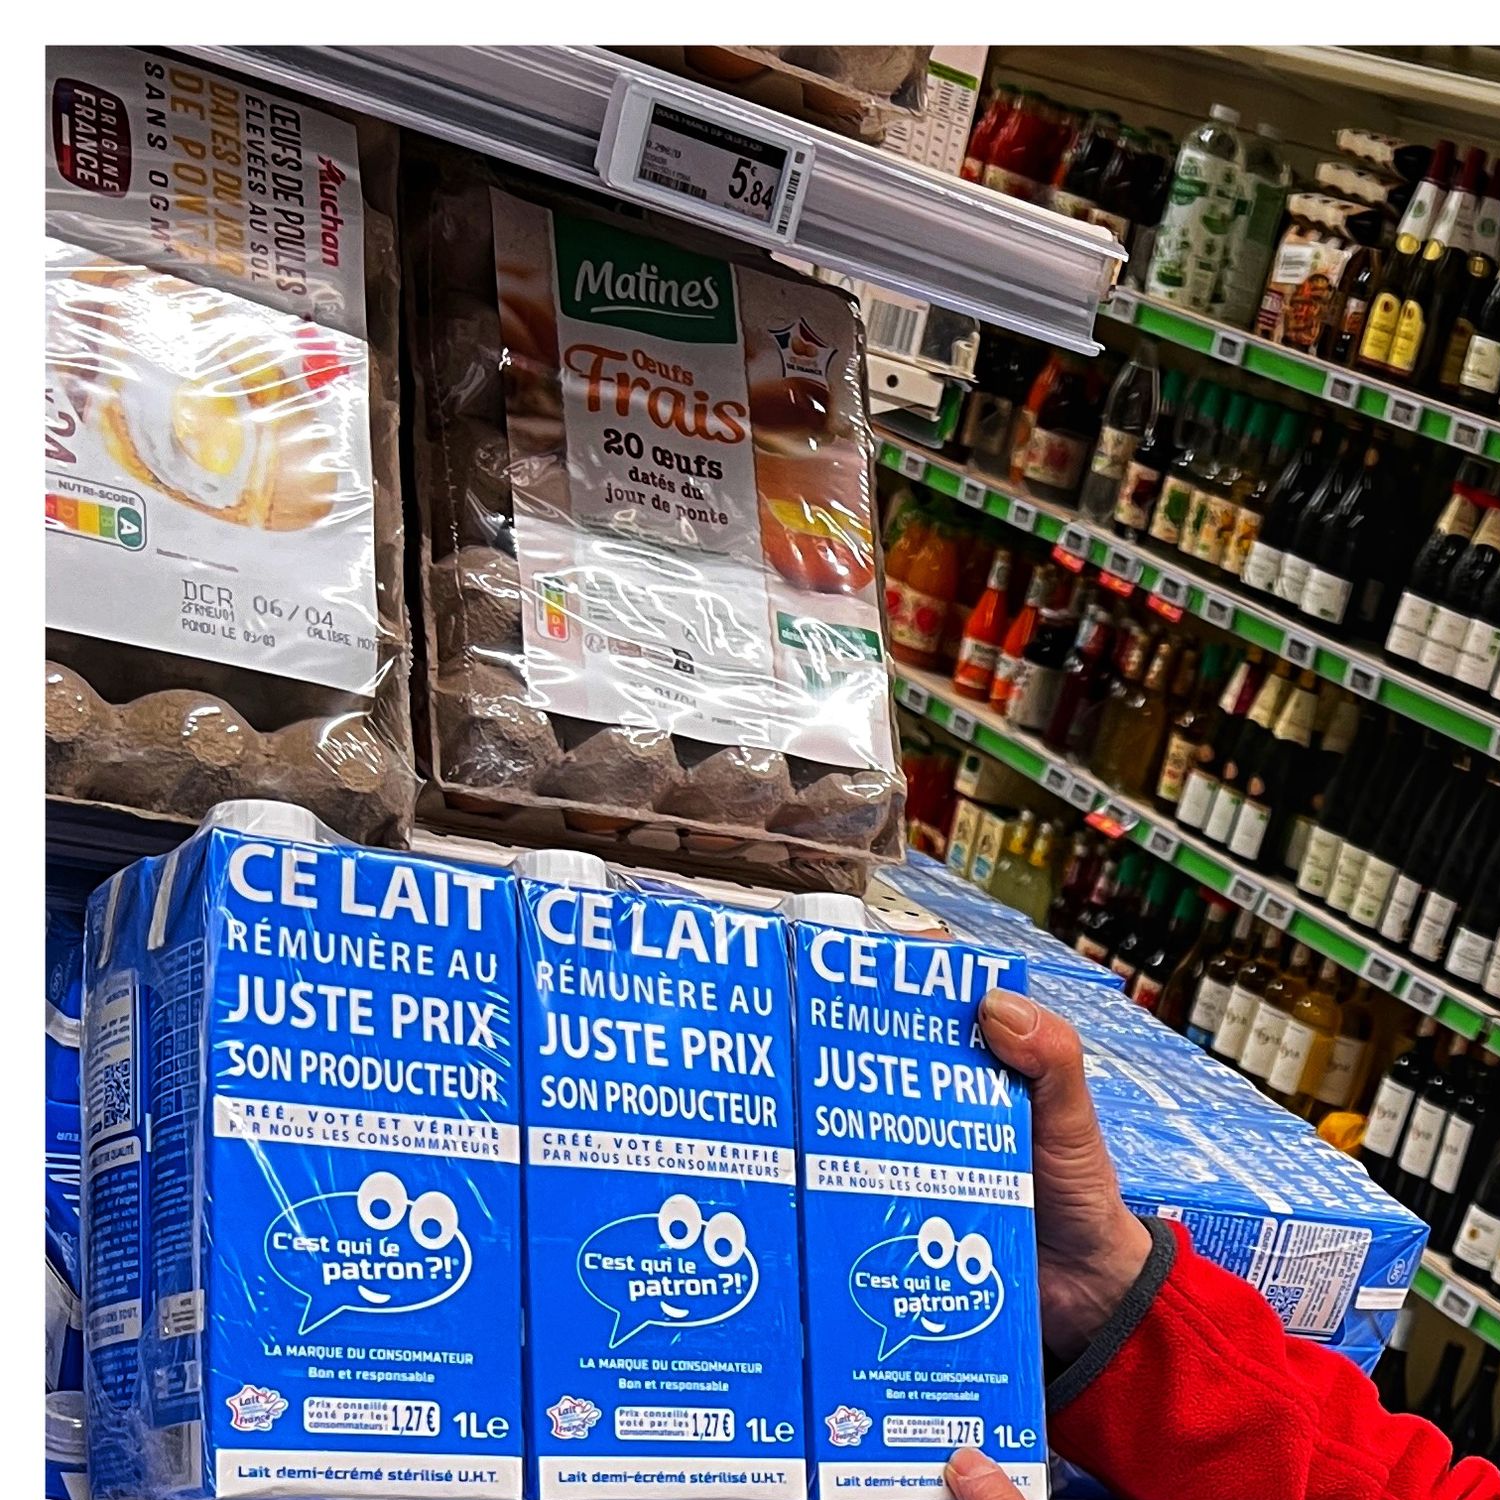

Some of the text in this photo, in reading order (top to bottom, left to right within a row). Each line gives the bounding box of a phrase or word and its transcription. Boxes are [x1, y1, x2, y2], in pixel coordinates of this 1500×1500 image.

[145, 61, 168, 151] SANS
[169, 68, 205, 121] DE
[74, 89, 99, 186] FRANCE
[100, 98, 120, 192] ORIGINE
[212, 168, 243, 208] DU
[245, 94, 270, 282] ÉLEVÉES AU SOL
[271, 172, 305, 207] DE
[317, 153, 346, 268] Auchan
[214, 208, 246, 276] JOUR
[274, 207, 307, 296] POULES
[574, 259, 720, 310] Matines
[564, 343, 748, 445] Frais
[603, 428, 724, 481] 20 œufs
[58, 479, 135, 507] NUTRI-SCORE
[605, 482, 729, 525] jour de ponte
[628, 467, 706, 501] datés du
[182, 579, 233, 608] DCR
[222, 627, 237, 640] LE
[228, 844, 496, 931] CE LAIT
[227, 916, 497, 984] RÉMUNÈRE AU
[536, 889, 769, 968] CE LAIT
[536, 958, 772, 1017] RÉMUNÈRE AU
[810, 931, 1010, 1003] CE LAIT
[228, 974, 498, 1050] JUSTE PRIX
[810, 996, 986, 1050] RÉMUNÈRE A
[539, 1011, 776, 1078] JUSTE PRIX
[228, 1043, 499, 1102] SON PRODUCTEUR
[813, 1046, 1013, 1109] JUSTE PRIX
[309, 1109, 363, 1128] VOTÉ
[378, 1117, 401, 1130] ET
[414, 1119, 499, 1140] VÉRIFIÉ
[540, 1074, 778, 1129] SON PRODUCTEUR
[230, 1120, 500, 1155] PR NOUS LES CONSOMMATEURS
[543, 1133, 780, 1164] CRÉÉ, VOTÉ ET VÉRIFIÉ
[815, 1105, 1018, 1156] SON PRODUCTEUR
[543, 1149, 780, 1178] PAR NOUS LES CONSOMMATEURS
[272, 1231, 401, 1258] C'est qui le
[584, 1252, 697, 1276] C'est qui le
[855, 1271, 951, 1292] C'est qui le
[264, 1344, 474, 1366] LA MARQUE DU CONSOMMATEUR
[307, 1366, 435, 1384] Bon et responsable
[307, 1399, 332, 1410] Prix
[343, 1411, 366, 1422] par
[370, 1411, 389, 1421] les
[237, 1465, 500, 1484] Lait demi-écrémé stérilisé U.H.T.
[557, 1470, 788, 1485] Lait demi-écrémé stérilisé U.H.T.
[835, 1474, 943, 1489] Lait demi-écrémé
